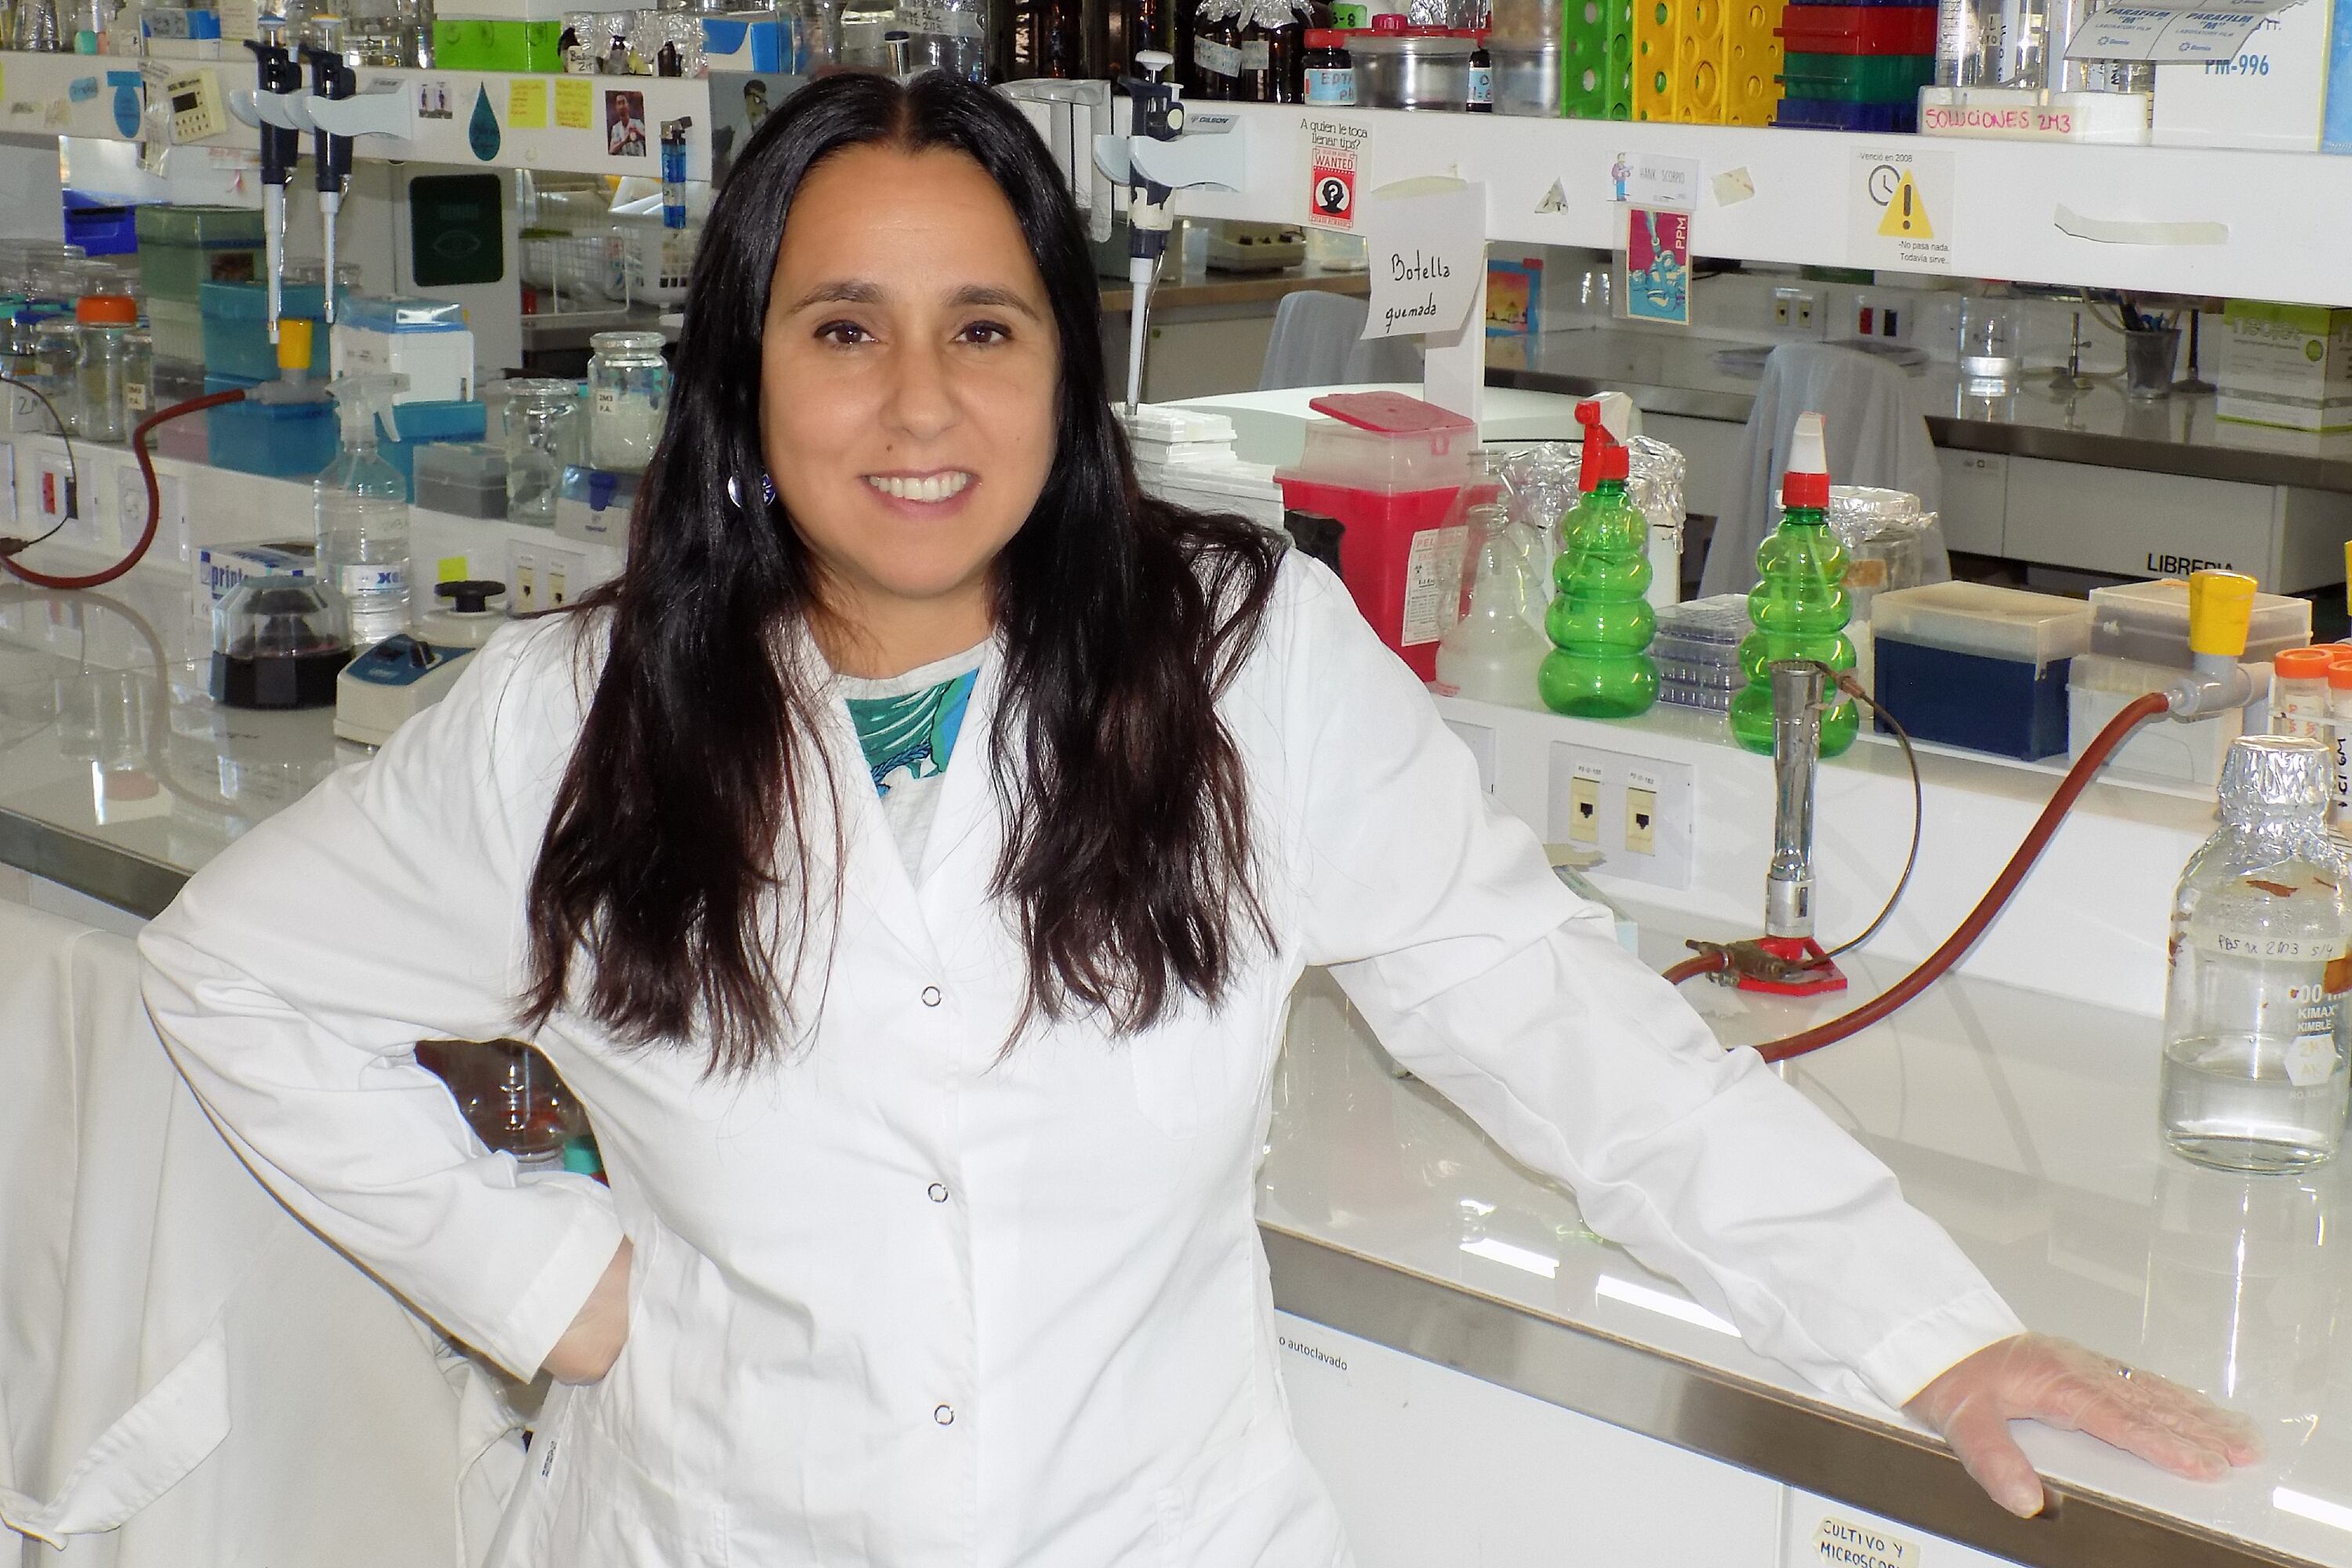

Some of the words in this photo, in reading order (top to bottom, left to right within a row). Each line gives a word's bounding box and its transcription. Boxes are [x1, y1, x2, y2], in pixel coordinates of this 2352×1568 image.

[2186, 13, 2254, 23] PARAFILM
[2205, 54, 2269, 76] PM-996
[1300, 118, 1308, 129] A
[1310, 121, 1336, 133] quien
[1338, 123, 1347, 135] le
[1348, 126, 1367, 138] toca
[1312, 132, 1338, 147] llenar
[1340, 137, 1361, 151] tips?
[1316, 154, 1353, 169] WANTED
[1675, 216, 1686, 250] PPM
[1392, 249, 1450, 281] Botella
[1385, 292, 1436, 334] quemada
[2298, 1005, 2336, 1019] KIMAX
[2297, 1019, 2332, 1033] KIMBLE
[1288, 1339, 1348, 1370] autoclavado
[1824, 1520, 1885, 1551] CULTIVO
[1893, 1542, 1903, 1558] Y
